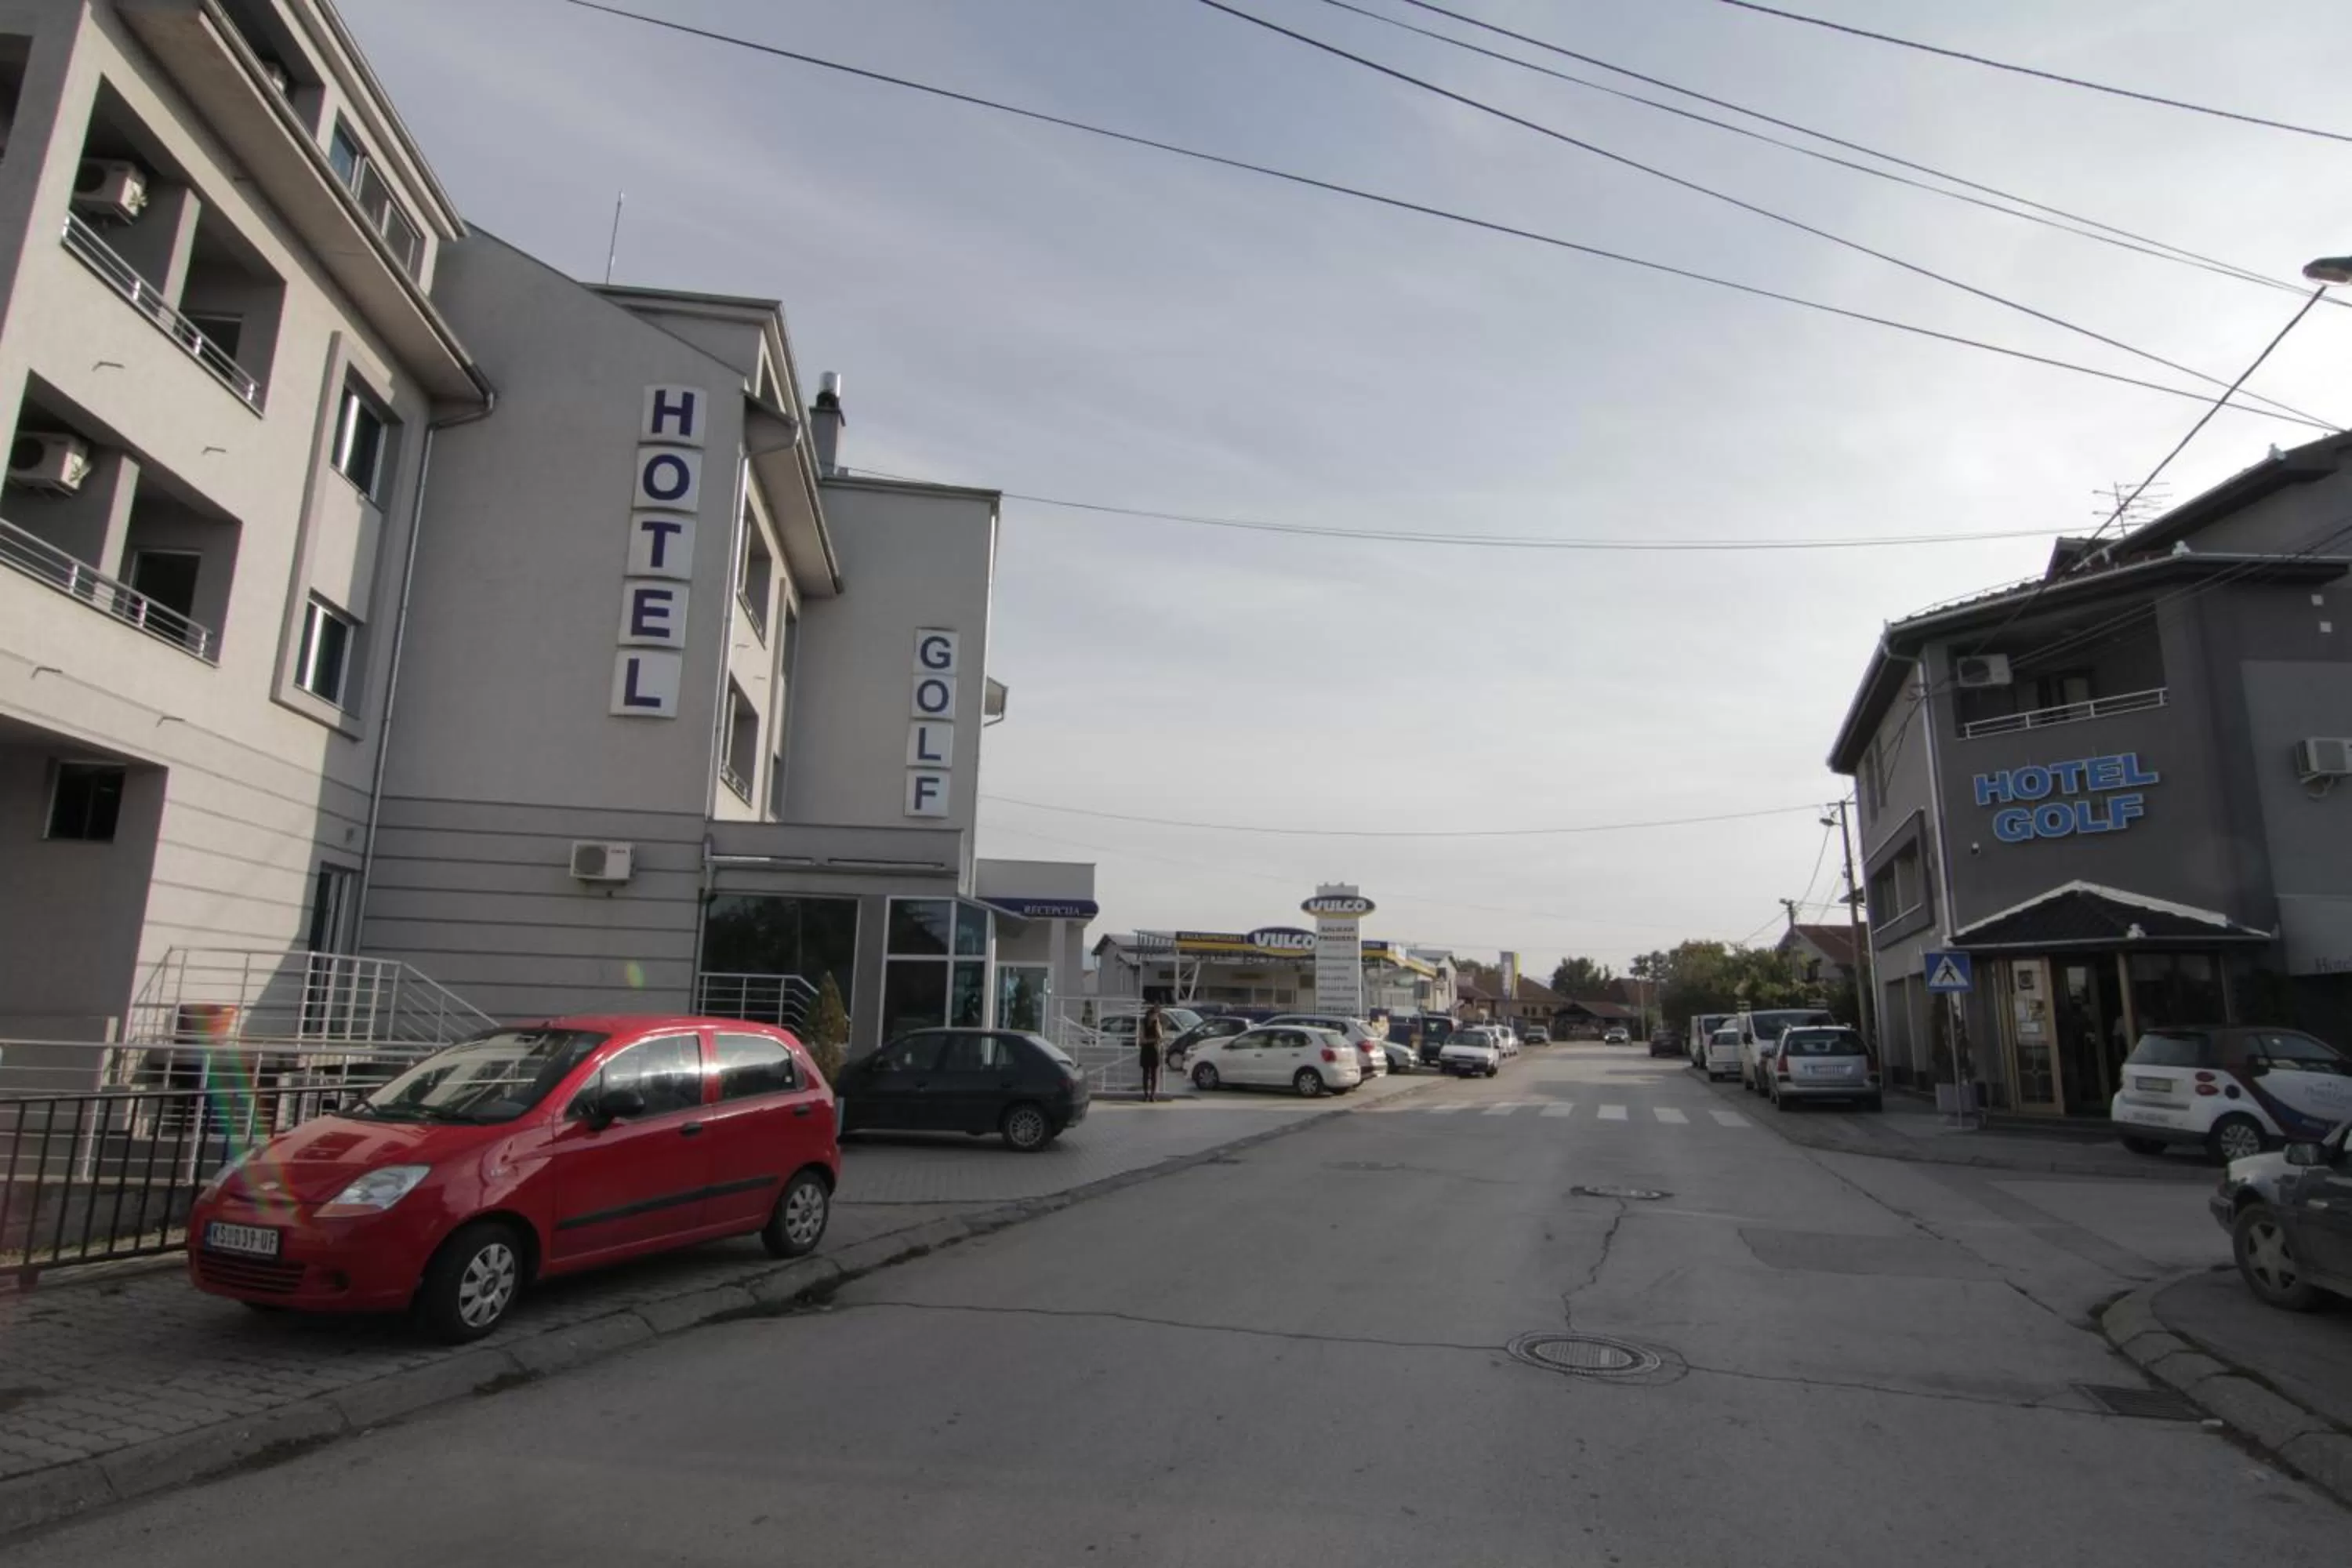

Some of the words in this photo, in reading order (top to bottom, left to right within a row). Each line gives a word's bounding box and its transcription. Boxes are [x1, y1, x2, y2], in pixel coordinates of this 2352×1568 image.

[623, 389, 695, 709] HOTEL
[913, 635, 953, 811] GOLF
[1973, 752, 2160, 806] HOTEL
[1993, 793, 2145, 843] GOLF
[1308, 898, 1367, 913] VULCO
[1254, 932, 1316, 950] VULCO
